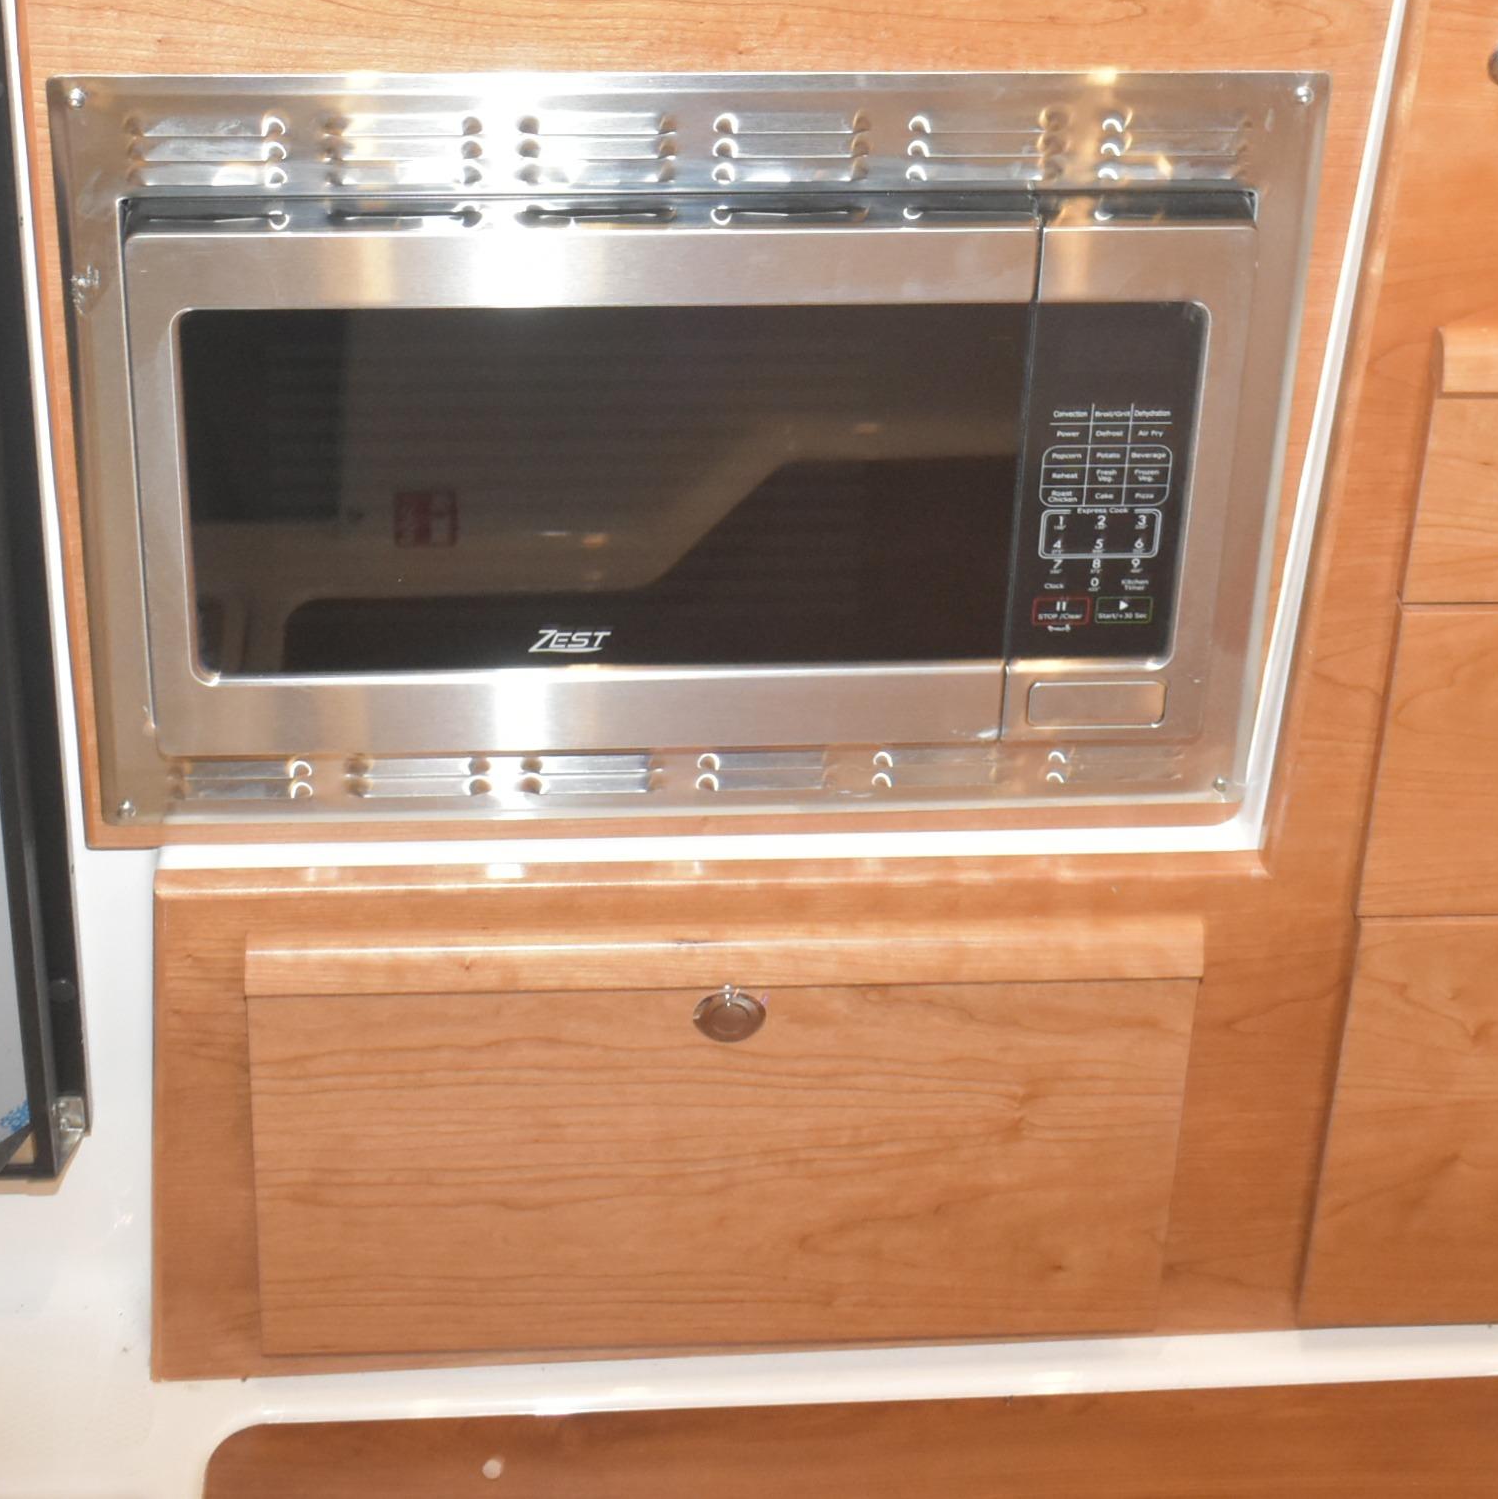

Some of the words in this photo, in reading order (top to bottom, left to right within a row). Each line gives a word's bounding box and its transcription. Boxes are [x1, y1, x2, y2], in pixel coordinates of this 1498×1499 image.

[1053, 410, 1088, 418] Convection
[1134, 410, 1171, 418] Dehydration
[1150, 430, 1164, 438] Fry
[1051, 452, 1082, 460] Popcorn
[1096, 452, 1120, 460] Potato
[1131, 452, 1166, 460] Beverage
[1097, 515, 1106, 525] 2
[1137, 515, 1147, 525] 3
[1053, 539, 1062, 549] 4
[1094, 539, 1104, 549] 5
[1134, 539, 1144, 549] 6
[1053, 559, 1063, 569] 7
[1092, 559, 1101, 569] 8
[1131, 559, 1140, 569] 9
[1090, 577, 1099, 587] 0
[528, 629, 611, 652] ZEST
